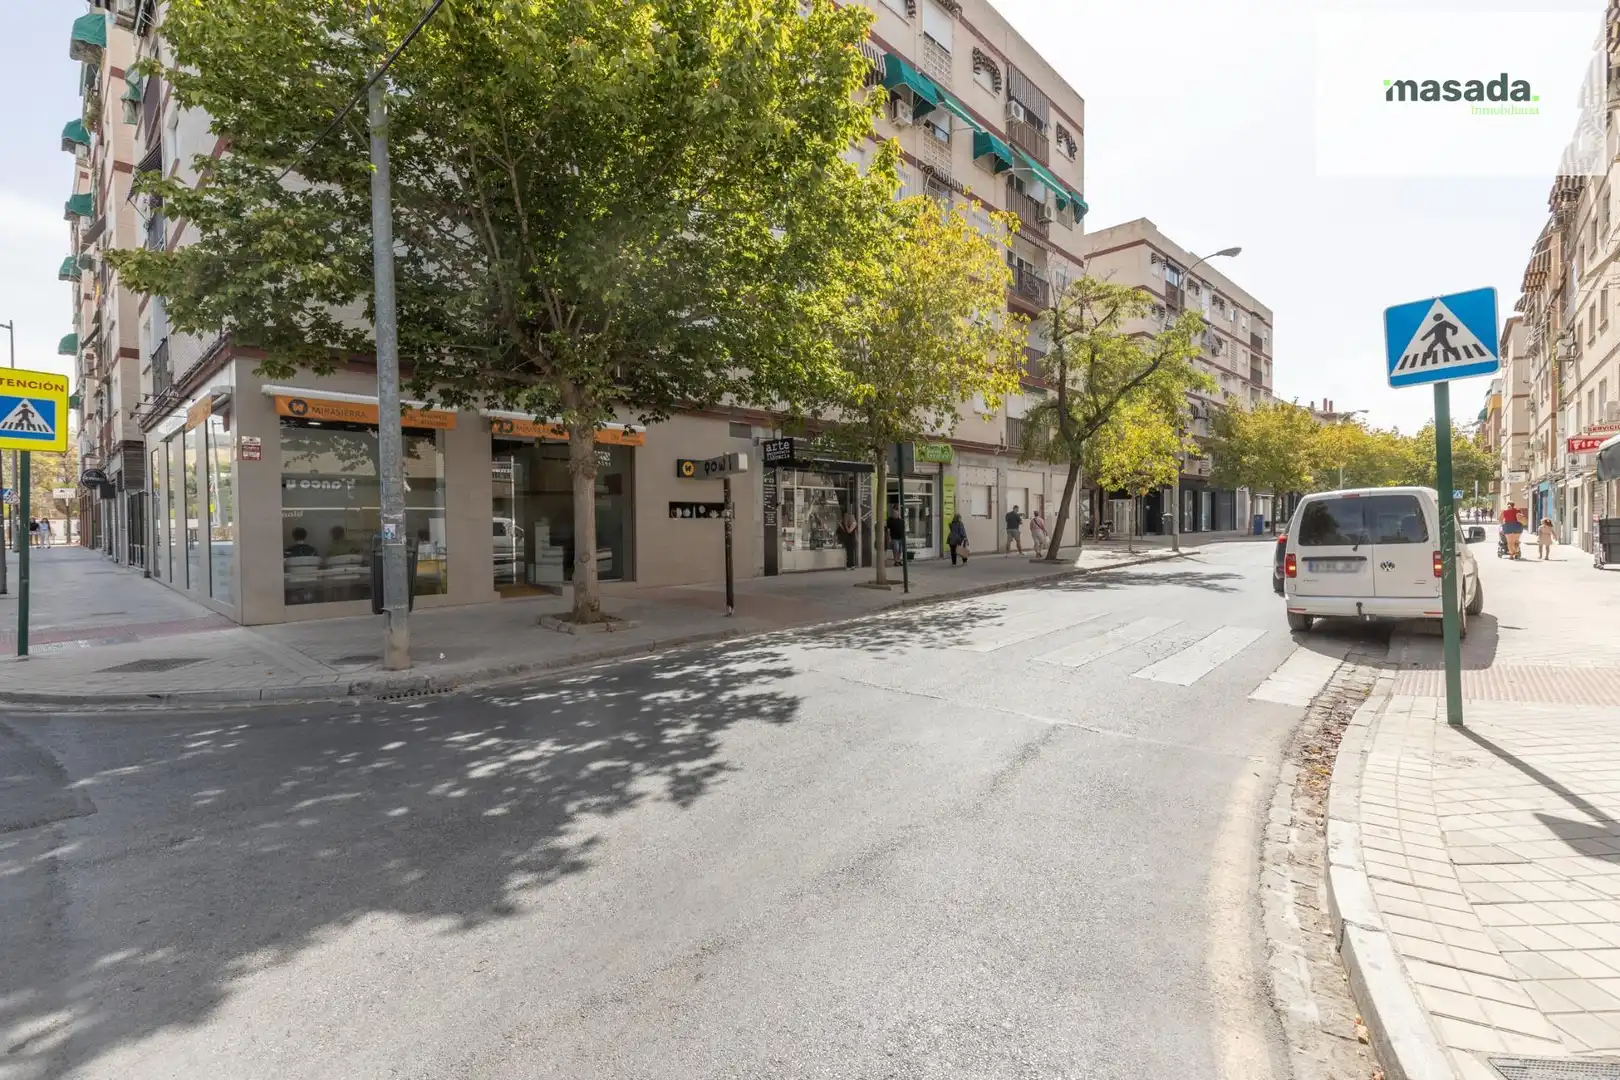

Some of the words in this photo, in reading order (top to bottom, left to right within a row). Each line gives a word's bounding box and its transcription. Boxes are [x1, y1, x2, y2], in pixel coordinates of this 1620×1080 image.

[0, 378, 65, 392] TENCIÓN
[311, 407, 368, 418] MIRASIERRA
[766, 441, 790, 452] arte
